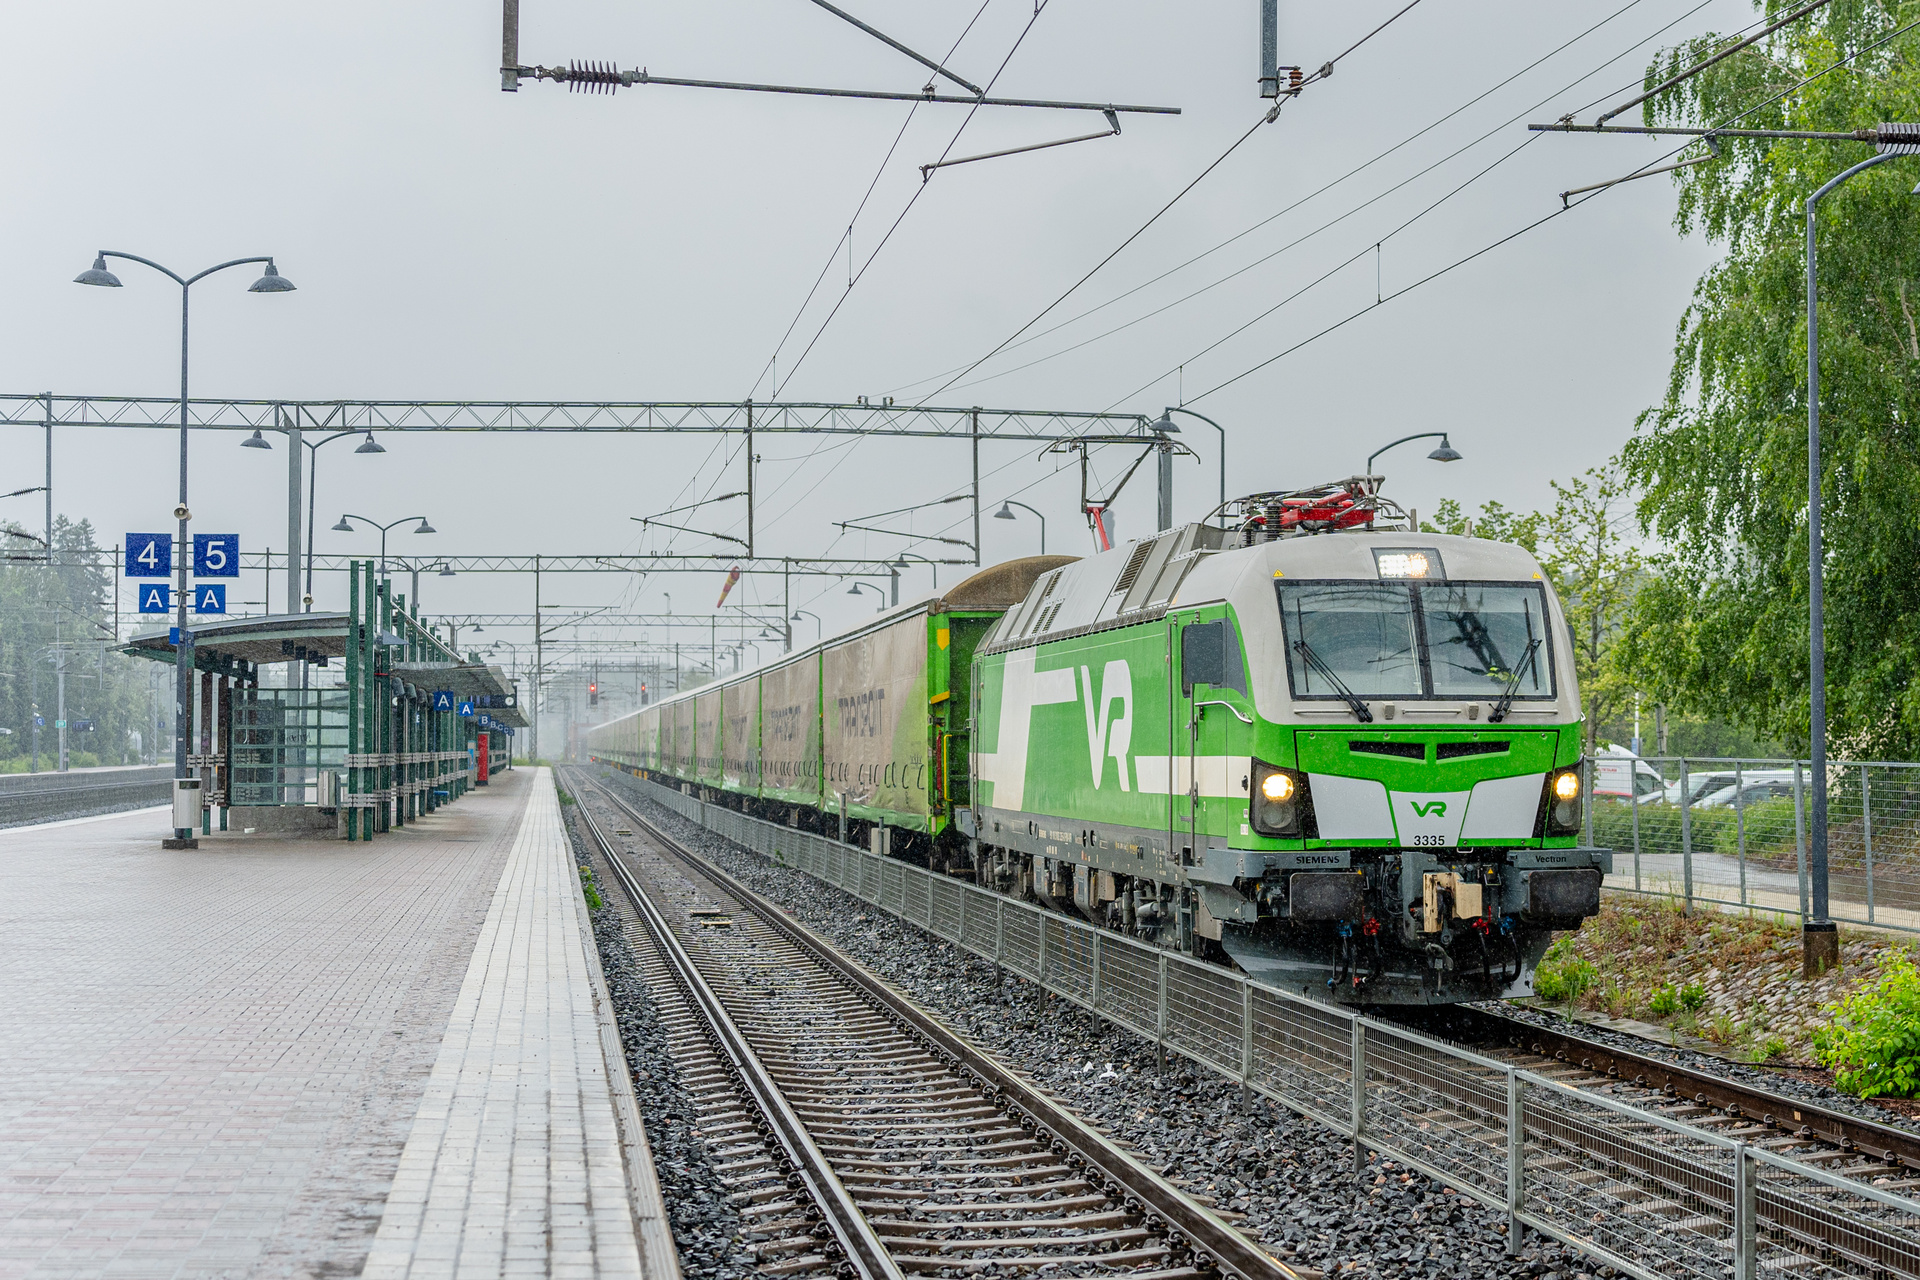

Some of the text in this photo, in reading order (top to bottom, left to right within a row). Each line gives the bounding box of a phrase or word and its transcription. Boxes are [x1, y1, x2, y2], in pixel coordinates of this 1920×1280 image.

[138, 541, 158, 569] 4
[206, 541, 226, 569] 5
[145, 589, 163, 608] A
[202, 589, 219, 608] A
[438, 695, 449, 707] A
[462, 704, 471, 714] A
[1081, 659, 1133, 792] VR
[1410, 801, 1447, 818] VR
[1413, 835, 1445, 846] 3335
[1296, 855, 1340, 864] SIEMENS
[1535, 855, 1567, 864] Vectron
